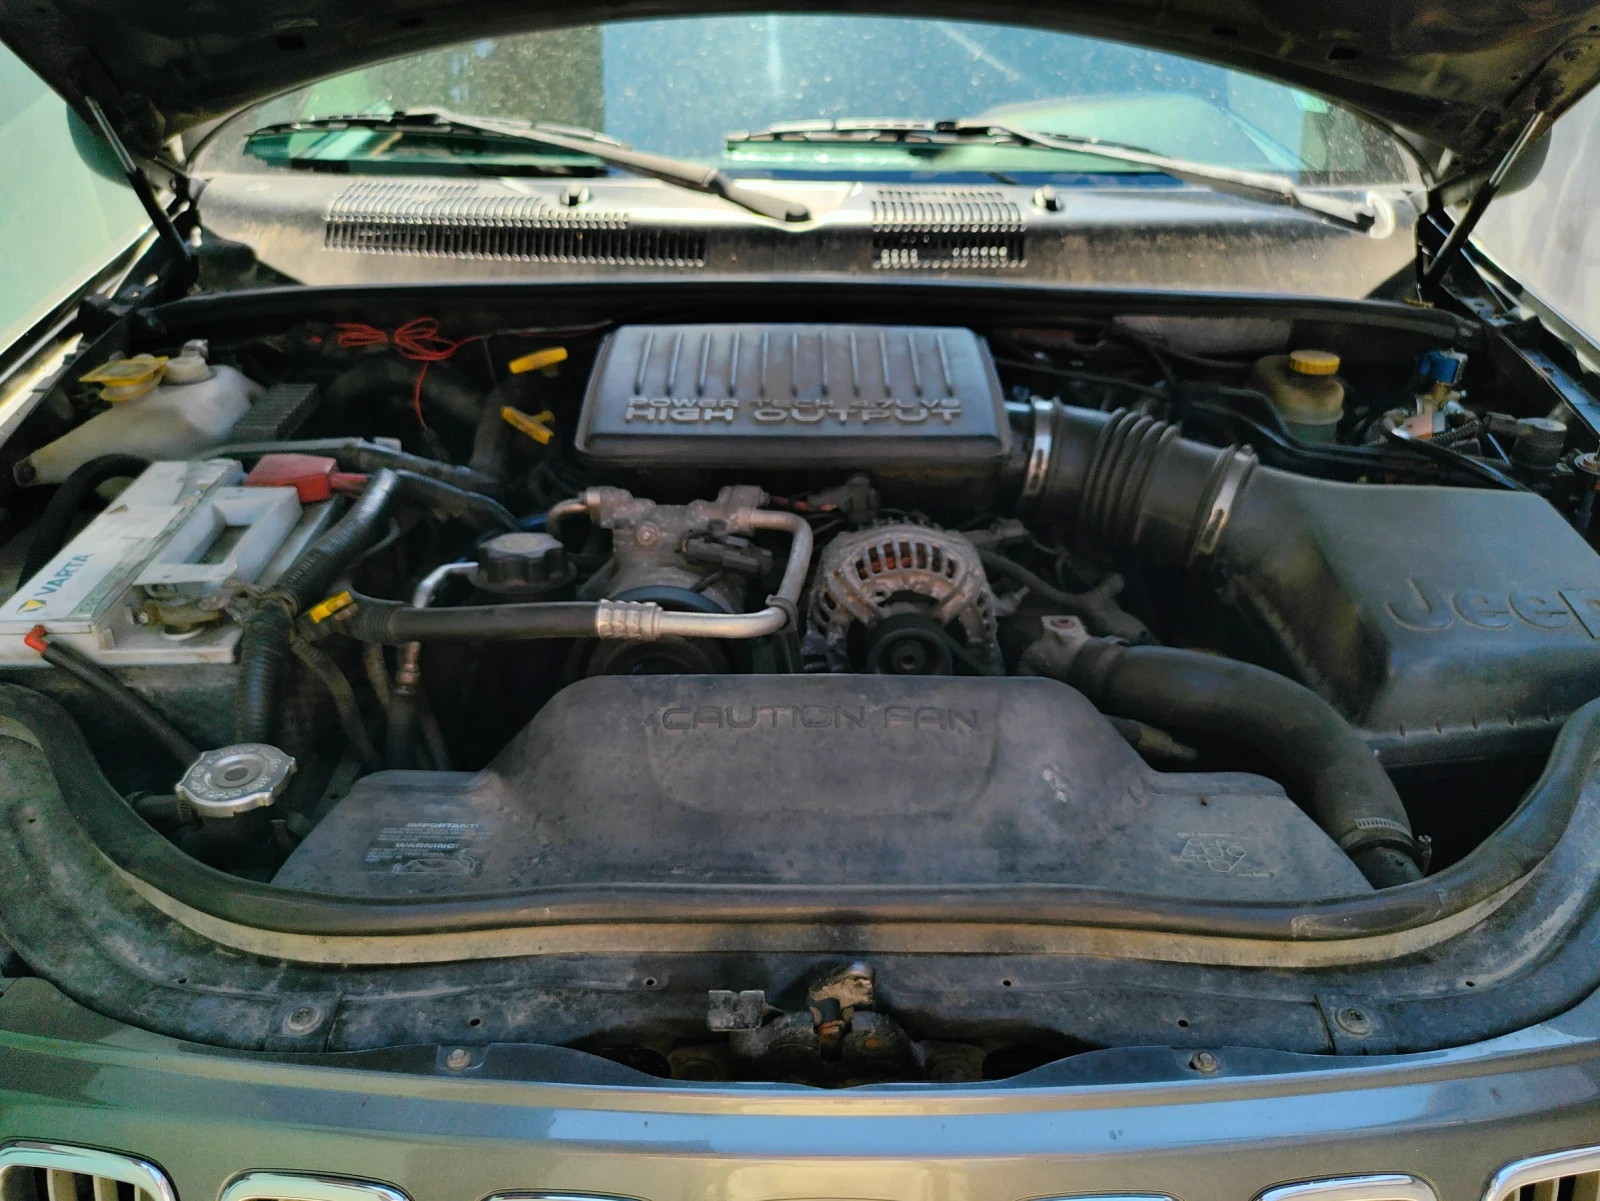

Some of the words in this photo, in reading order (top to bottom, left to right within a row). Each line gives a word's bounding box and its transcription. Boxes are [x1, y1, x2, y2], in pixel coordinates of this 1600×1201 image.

[628, 396, 739, 408] POWER
[625, 407, 734, 422] HIGH
[753, 408, 962, 423] OUTPUT
[33, 553, 95, 596] VARTA
[661, 705, 867, 731] CAUTION
[883, 705, 981, 731] FAN
